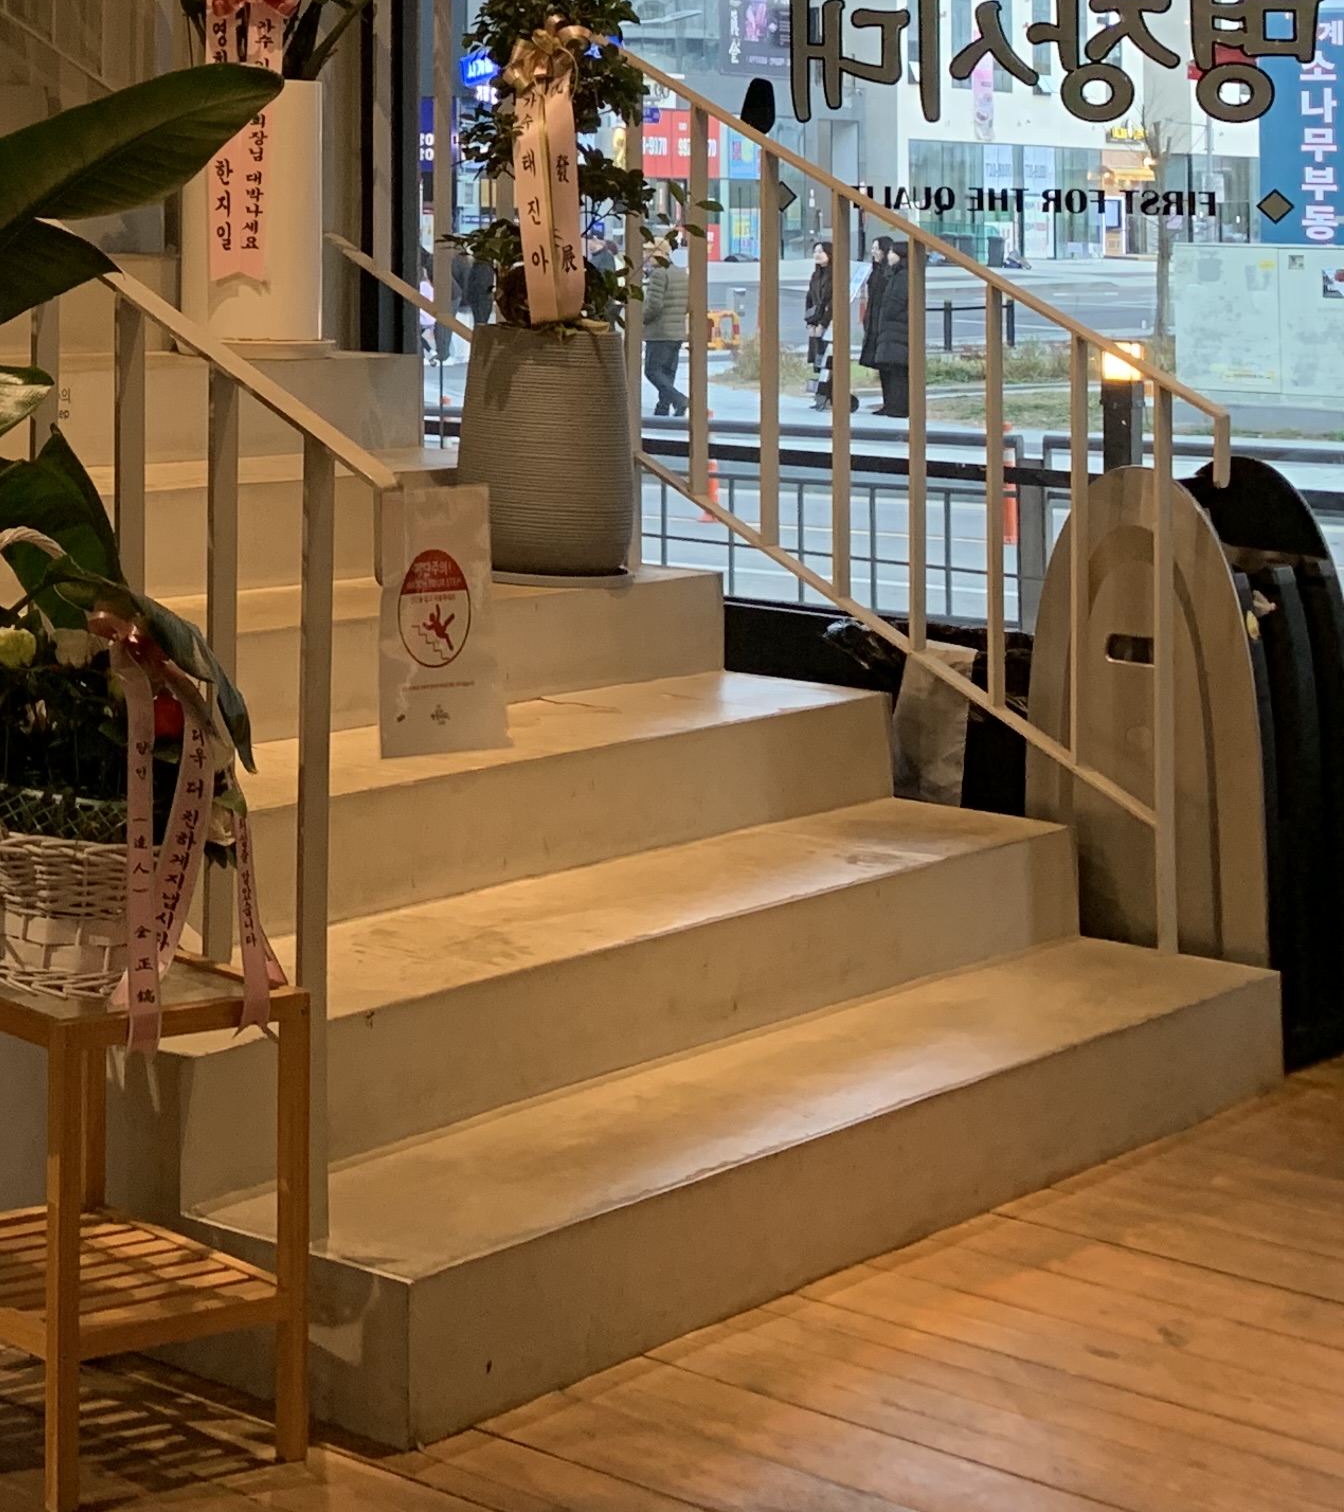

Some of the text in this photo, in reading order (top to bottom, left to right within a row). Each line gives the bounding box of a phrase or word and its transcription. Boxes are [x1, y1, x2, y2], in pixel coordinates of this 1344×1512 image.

[255, 18, 277, 49] 가수
[520, 92, 550, 275] 가수 태진아
[1299, 50, 1339, 246] 소나무부동
[214, 158, 234, 251] 한지일
[241, 170, 264, 251] 대박나세요
[186, 781, 205, 799] 더
